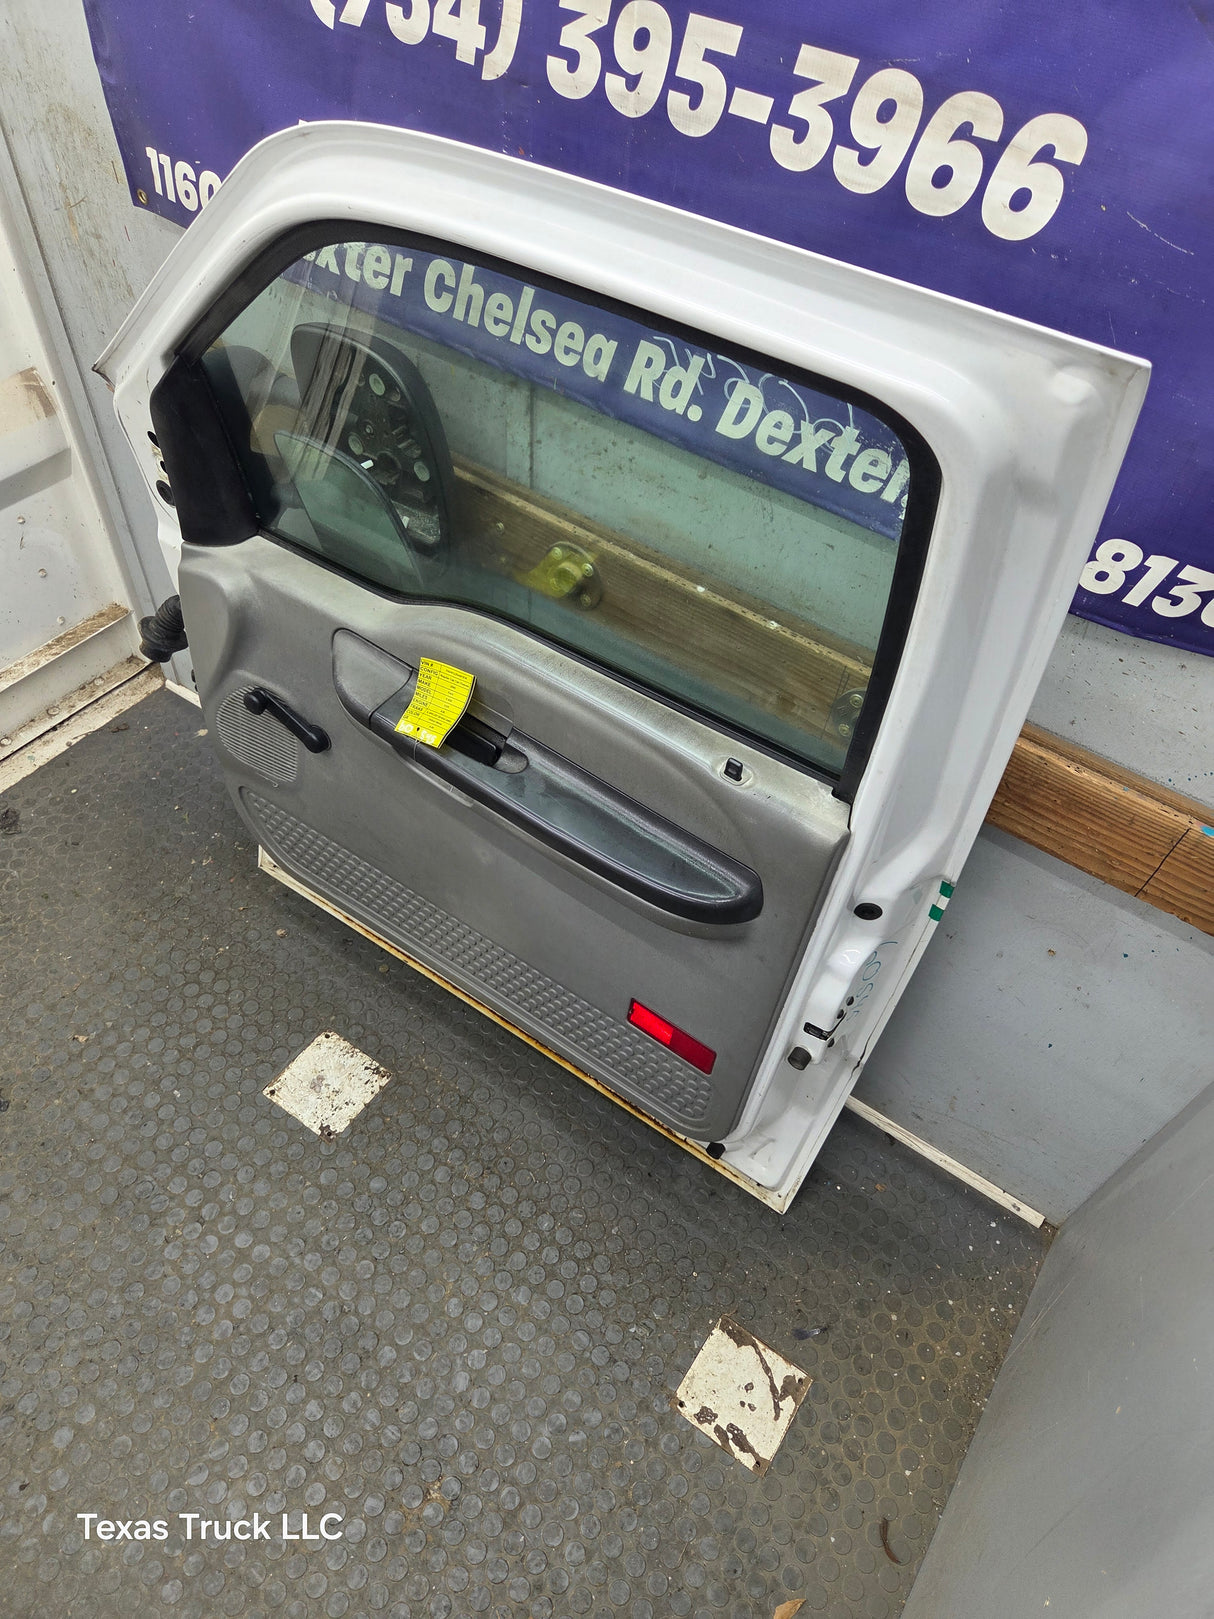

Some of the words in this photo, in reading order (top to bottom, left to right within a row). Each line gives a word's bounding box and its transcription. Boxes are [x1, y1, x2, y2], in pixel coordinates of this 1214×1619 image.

[547, 0, 1088, 241] 395-3966
[302, 241, 414, 297] xter
[424, 258, 619, 383] Chelsea
[623, 340, 703, 422] Rd.
[1079, 538, 1214, 628] 813
